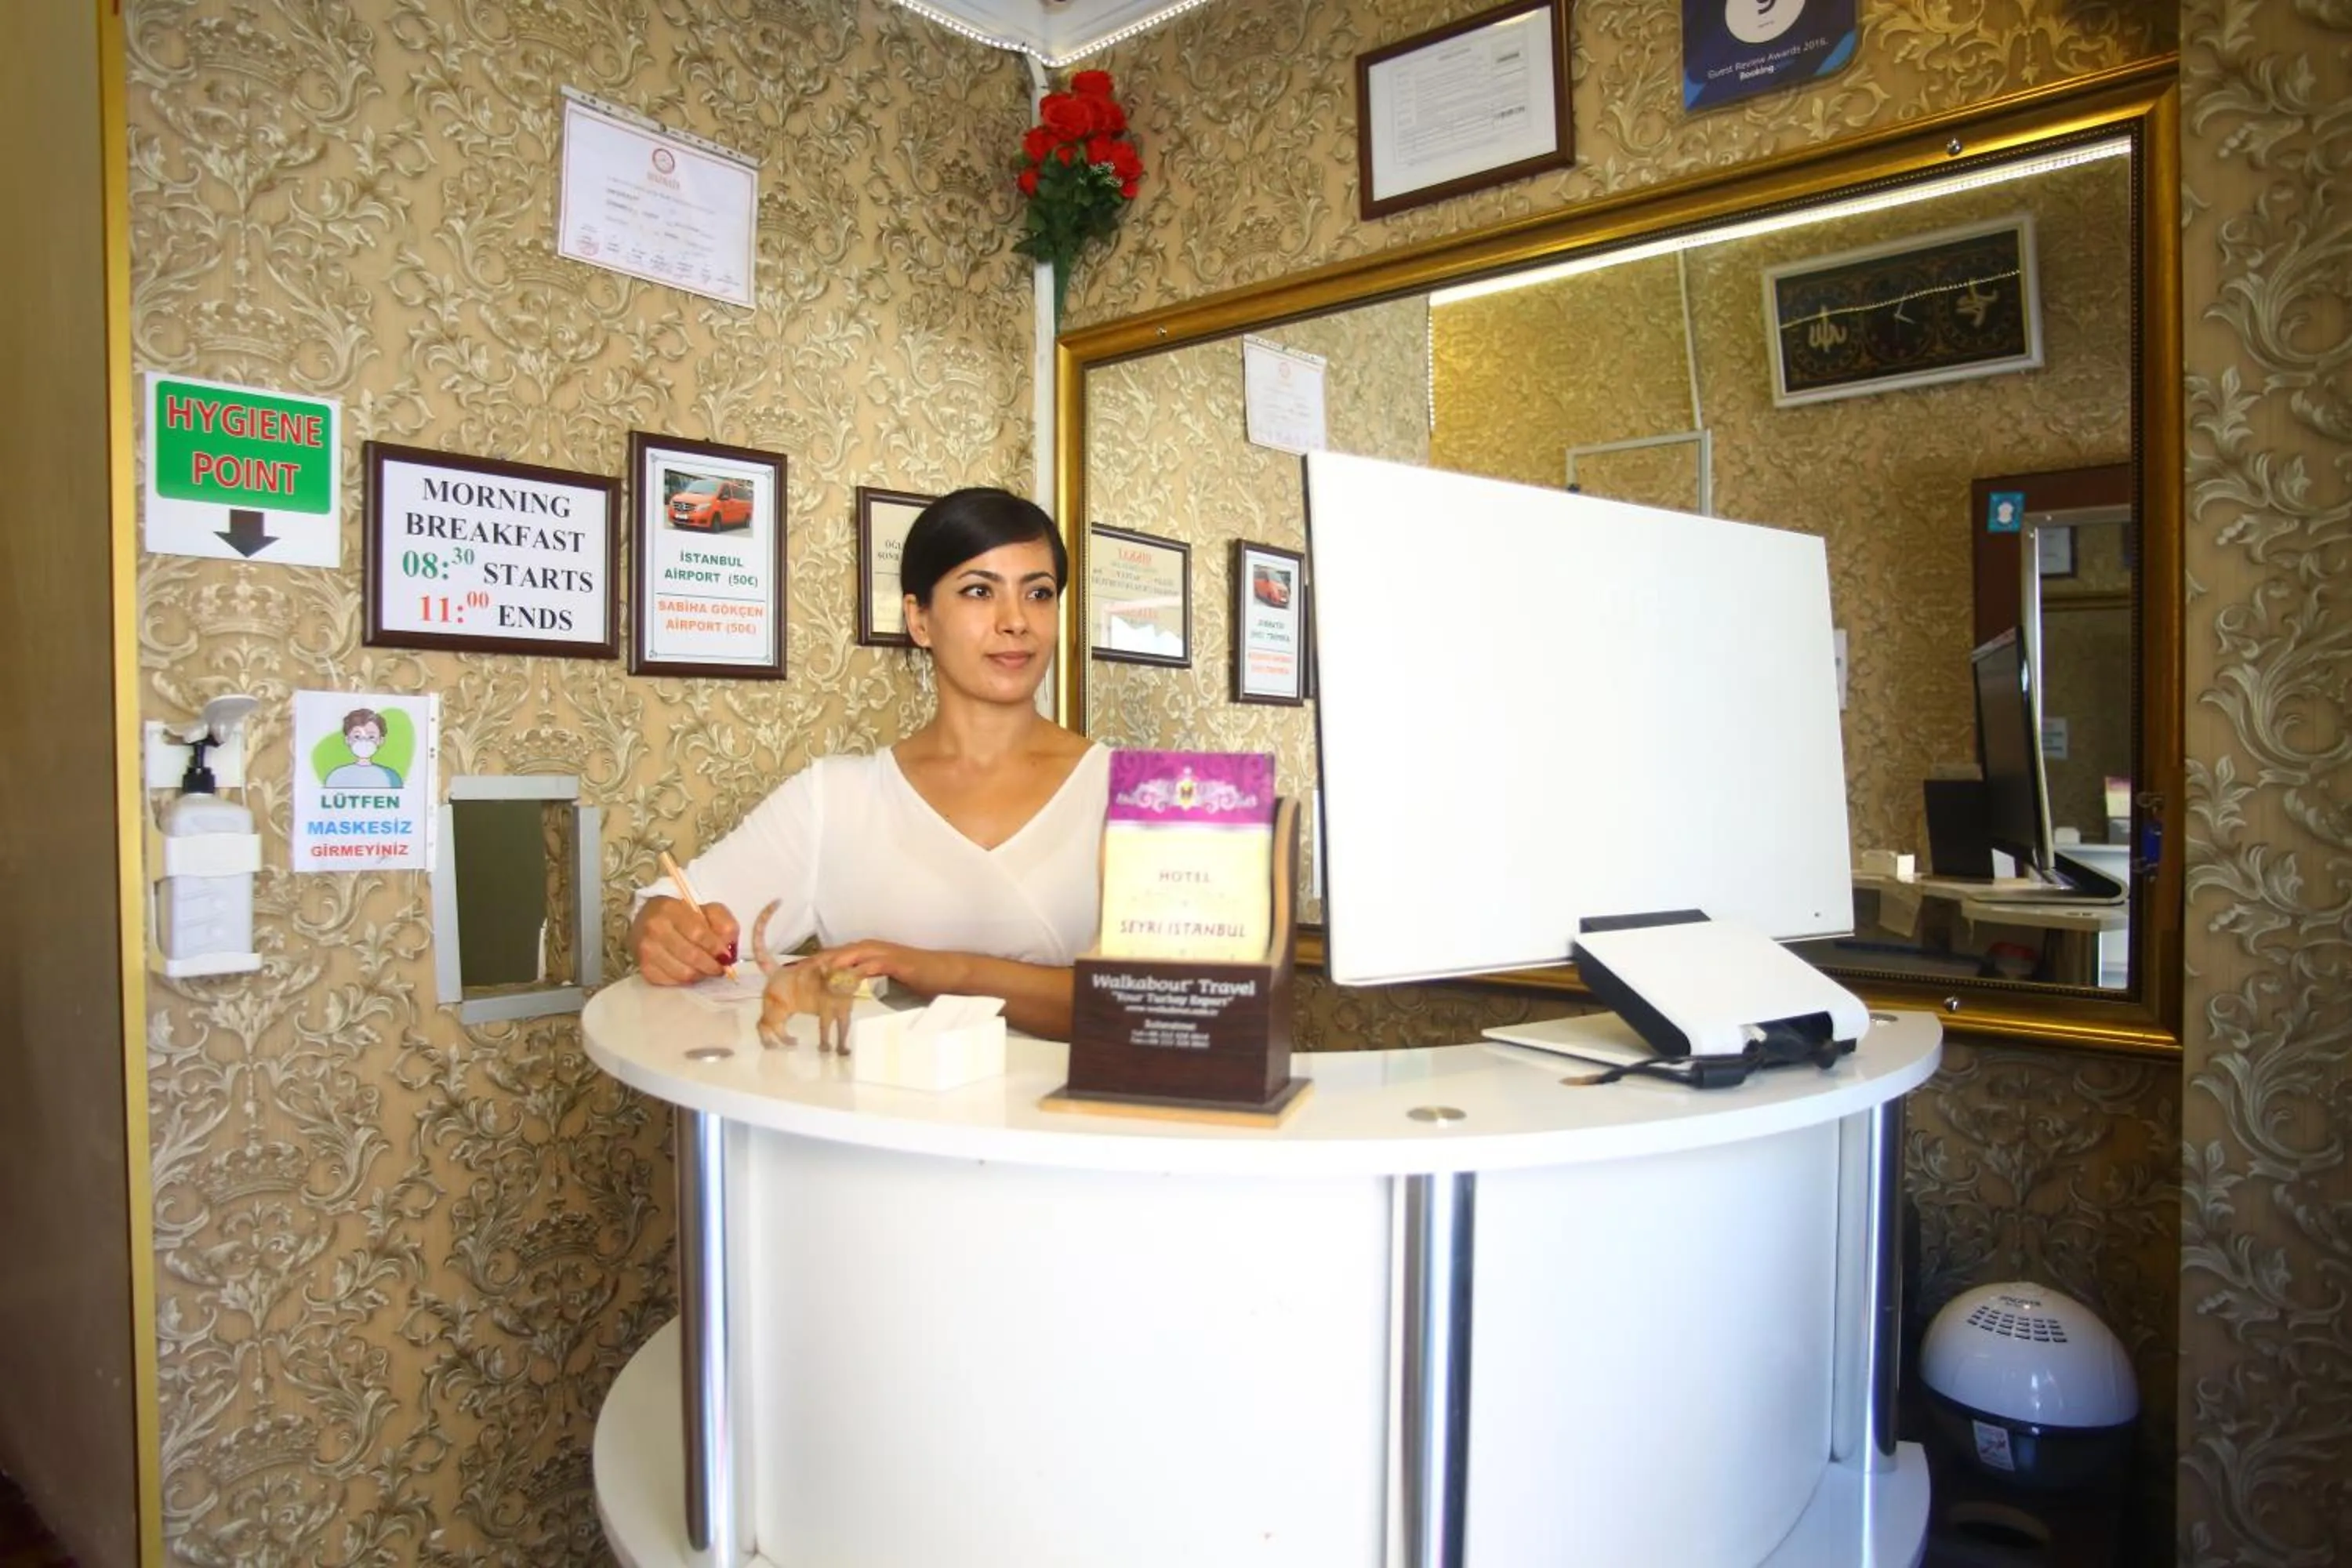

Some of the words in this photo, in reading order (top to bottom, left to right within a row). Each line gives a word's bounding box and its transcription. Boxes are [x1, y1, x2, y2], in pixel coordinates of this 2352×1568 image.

[1768, 46, 1801, 61] Awards
[166, 394, 323, 448] HYGIENE
[192, 451, 301, 495] POINT
[422, 477, 571, 518] MORNING
[405, 512, 586, 553] BREAKFAST
[680, 550, 743, 567] İSTANBUL
[483, 562, 593, 593] STARTS
[728, 574, 758, 587] (50€)
[499, 604, 573, 631] ENDS
[321, 793, 400, 809] LÜTFEN
[307, 818, 412, 835] MASKESİZ
[310, 842, 408, 857] GİRMEYİNİZ
[1159, 871, 1210, 883] HOTEL
[1197, 978, 1256, 996] Travel
